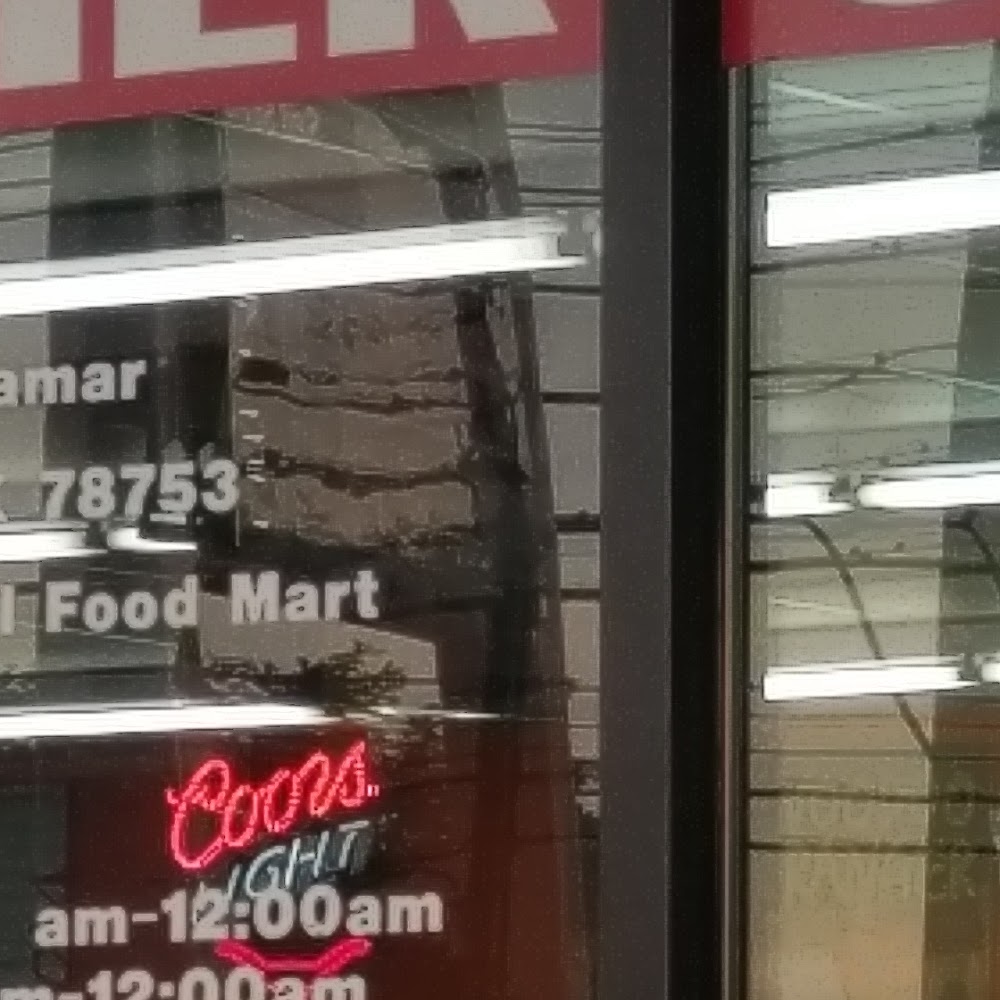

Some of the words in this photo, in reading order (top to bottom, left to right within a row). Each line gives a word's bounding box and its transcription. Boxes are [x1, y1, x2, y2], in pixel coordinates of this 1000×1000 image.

[40, 459, 240, 523] 78753
[45, 574, 198, 633] Food
[230, 569, 381, 625] Mart
[166, 741, 366, 869] Coors
[200, 819, 370, 902] IGHT
